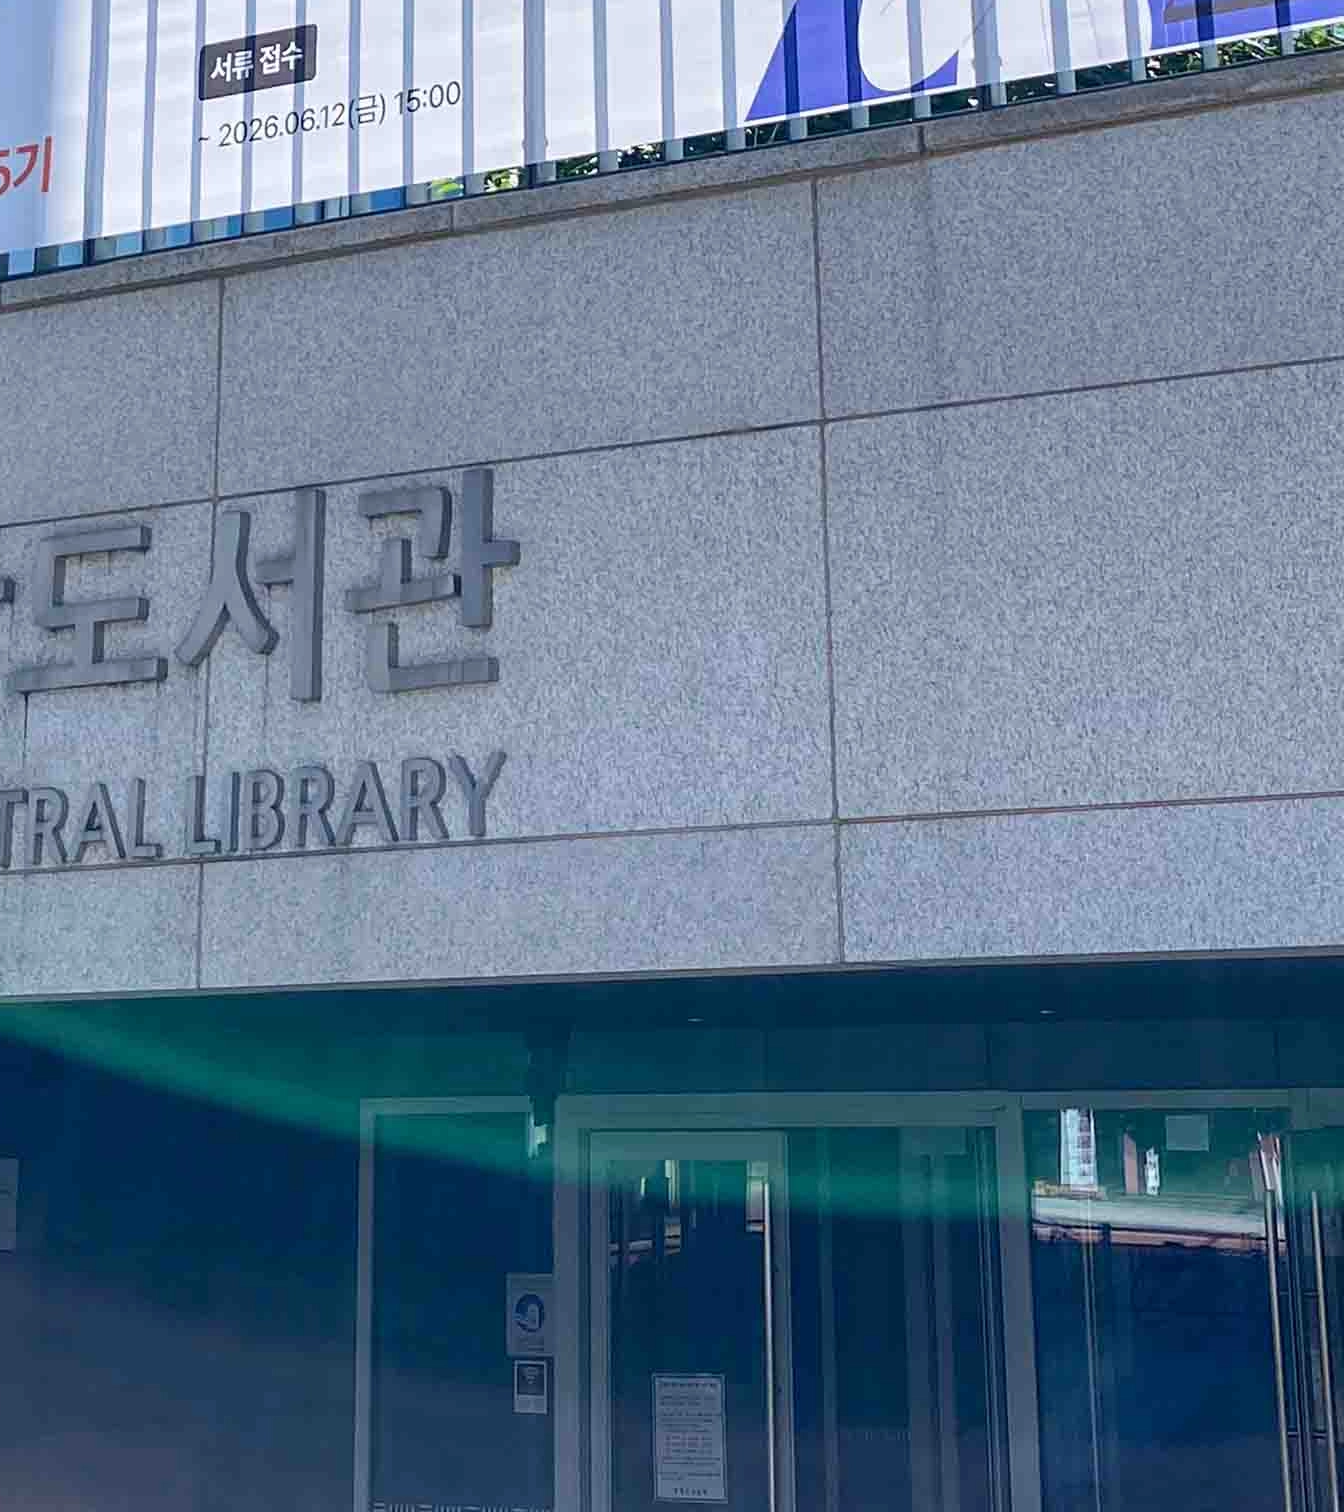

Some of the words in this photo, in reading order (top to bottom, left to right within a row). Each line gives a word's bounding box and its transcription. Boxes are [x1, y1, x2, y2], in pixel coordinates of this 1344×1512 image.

[210, 49, 254, 82] 서류
[259, 41, 304, 75] 접수
[218, 92, 386, 147] 2026.06.12(금)
[394, 80, 462, 116] 15:00
[183, 751, 506, 857] LIBRARY
